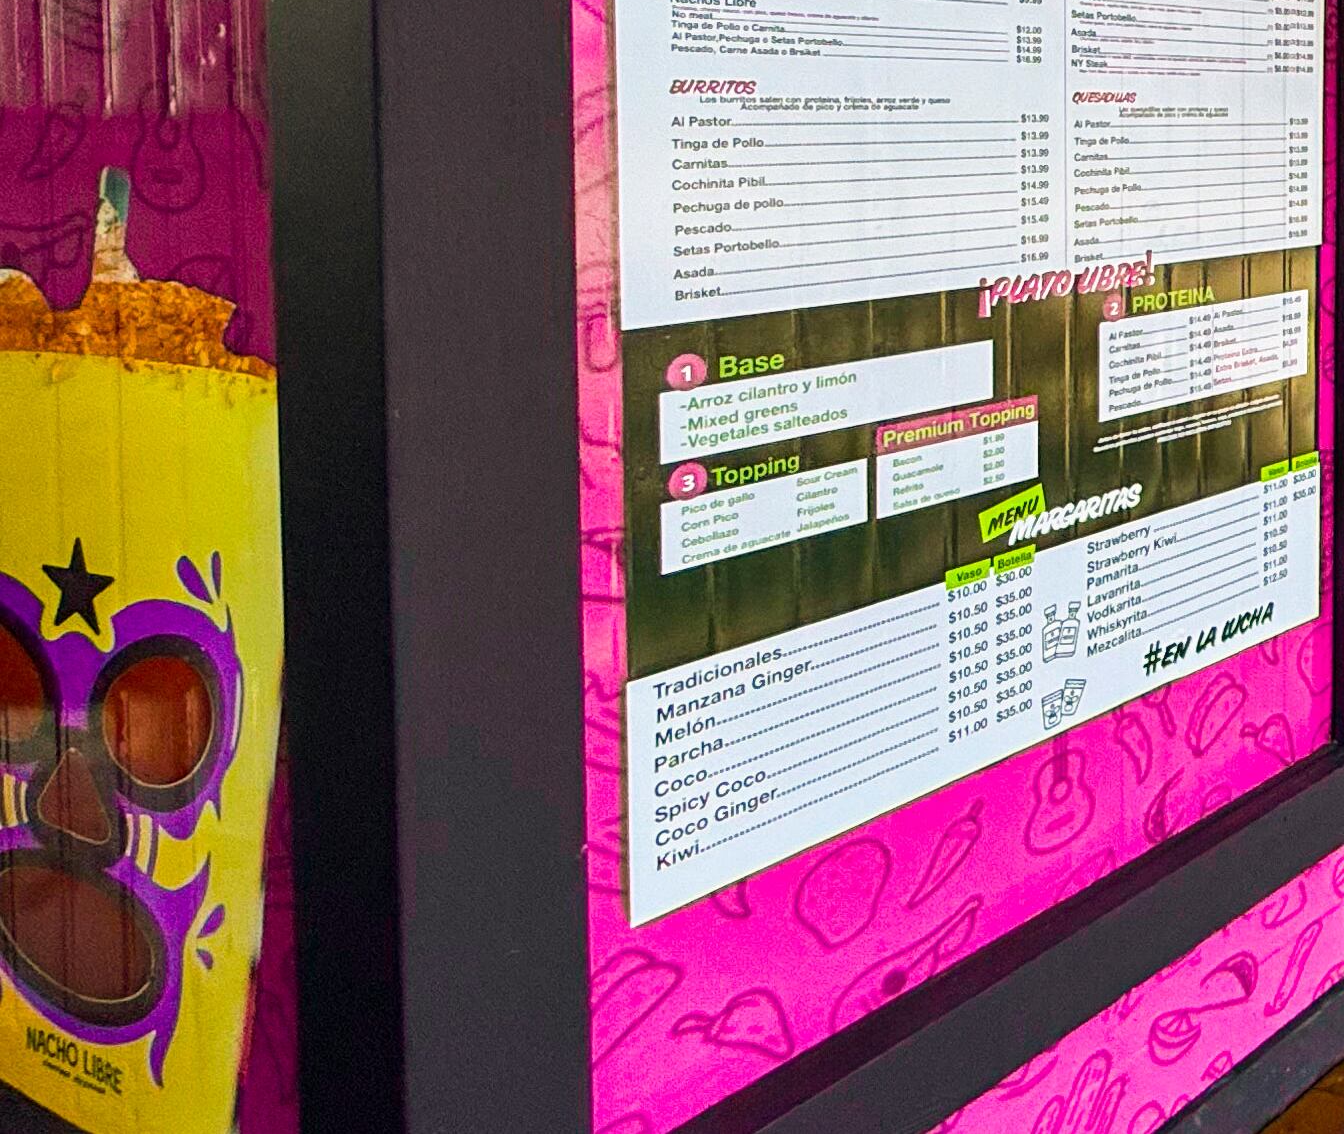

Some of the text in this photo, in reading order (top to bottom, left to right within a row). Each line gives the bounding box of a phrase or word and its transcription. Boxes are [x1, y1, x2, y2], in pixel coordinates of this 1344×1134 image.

[671, 20, 699, 31] Tinga
[702, 22, 713, 30] de
[672, 10, 686, 18] No
[669, 79, 757, 94] BURRITOS
[671, 114, 1049, 127] Al Pastor $13.99
[672, 131, 1049, 151] Tinga de Pollo $13.99
[672, 148, 1049, 170] Carnitas $13.99
[672, 165, 1049, 191] Cochinita Pibil $13.99
[673, 180, 1049, 214] Pechuga de pollo $14.99
[675, 223, 732, 236] Pescado
[673, 239, 780, 257] Setas Portobello
[673, 267, 714, 280] Asada
[675, 287, 722, 301] Brisket
[1110, 303, 1118, 315] 2
[681, 353, 785, 381] 1 Base
[739, 383, 798, 402] cilantro
[803, 381, 811, 394] y
[817, 372, 857, 389] limón
[744, 402, 798, 423] greens
[774, 408, 848, 431] salteados
[883, 404, 1035, 448] Premium Topping
[682, 455, 800, 492] 3 Topping
[681, 504, 707, 516] Pico
[710, 500, 724, 510] de
[727, 492, 755, 508] gallo
[681, 486, 838, 532] Corn Pico Cilantro
[797, 501, 835, 517] Frijoles
[988, 483, 1143, 546] MENU MARGARITAS
[723, 544, 738, 554] de
[1087, 526, 1150, 555] Strawberry
[1087, 546, 1150, 574] Strawberry
[1153, 533, 1178, 551] Kiwi
[957, 552, 1032, 582] Vaso Botella
[1087, 564, 1139, 590] Pamarita
[1087, 579, 1142, 608] Lavanrita
[1087, 596, 1142, 623] Vodkarita
[654, 566, 1032, 700] Tradicionales $10.00 $30.00
[1087, 608, 1148, 641] Whiskyrita
[1143, 601, 1275, 677] #EN LA LUCHA
[656, 587, 1032, 724] Manzana Ginger $10.50 $35.00
[1087, 627, 1142, 658] Mezcalita
[655, 603, 1032, 748] Melón $10.50 $35.00
[654, 624, 1032, 773] Parcha $10.50 $35.00
[655, 643, 1032, 797] Coco $10.50 $35.00
[655, 662, 1032, 823] Spicy Coco $10.50 $35.00
[655, 680, 1032, 846] Coco Ginger $10.50 $35.00
[656, 699, 1032, 872] Kiwi $11.00 $35.00
[26, 1027, 78, 1067] NACHO
